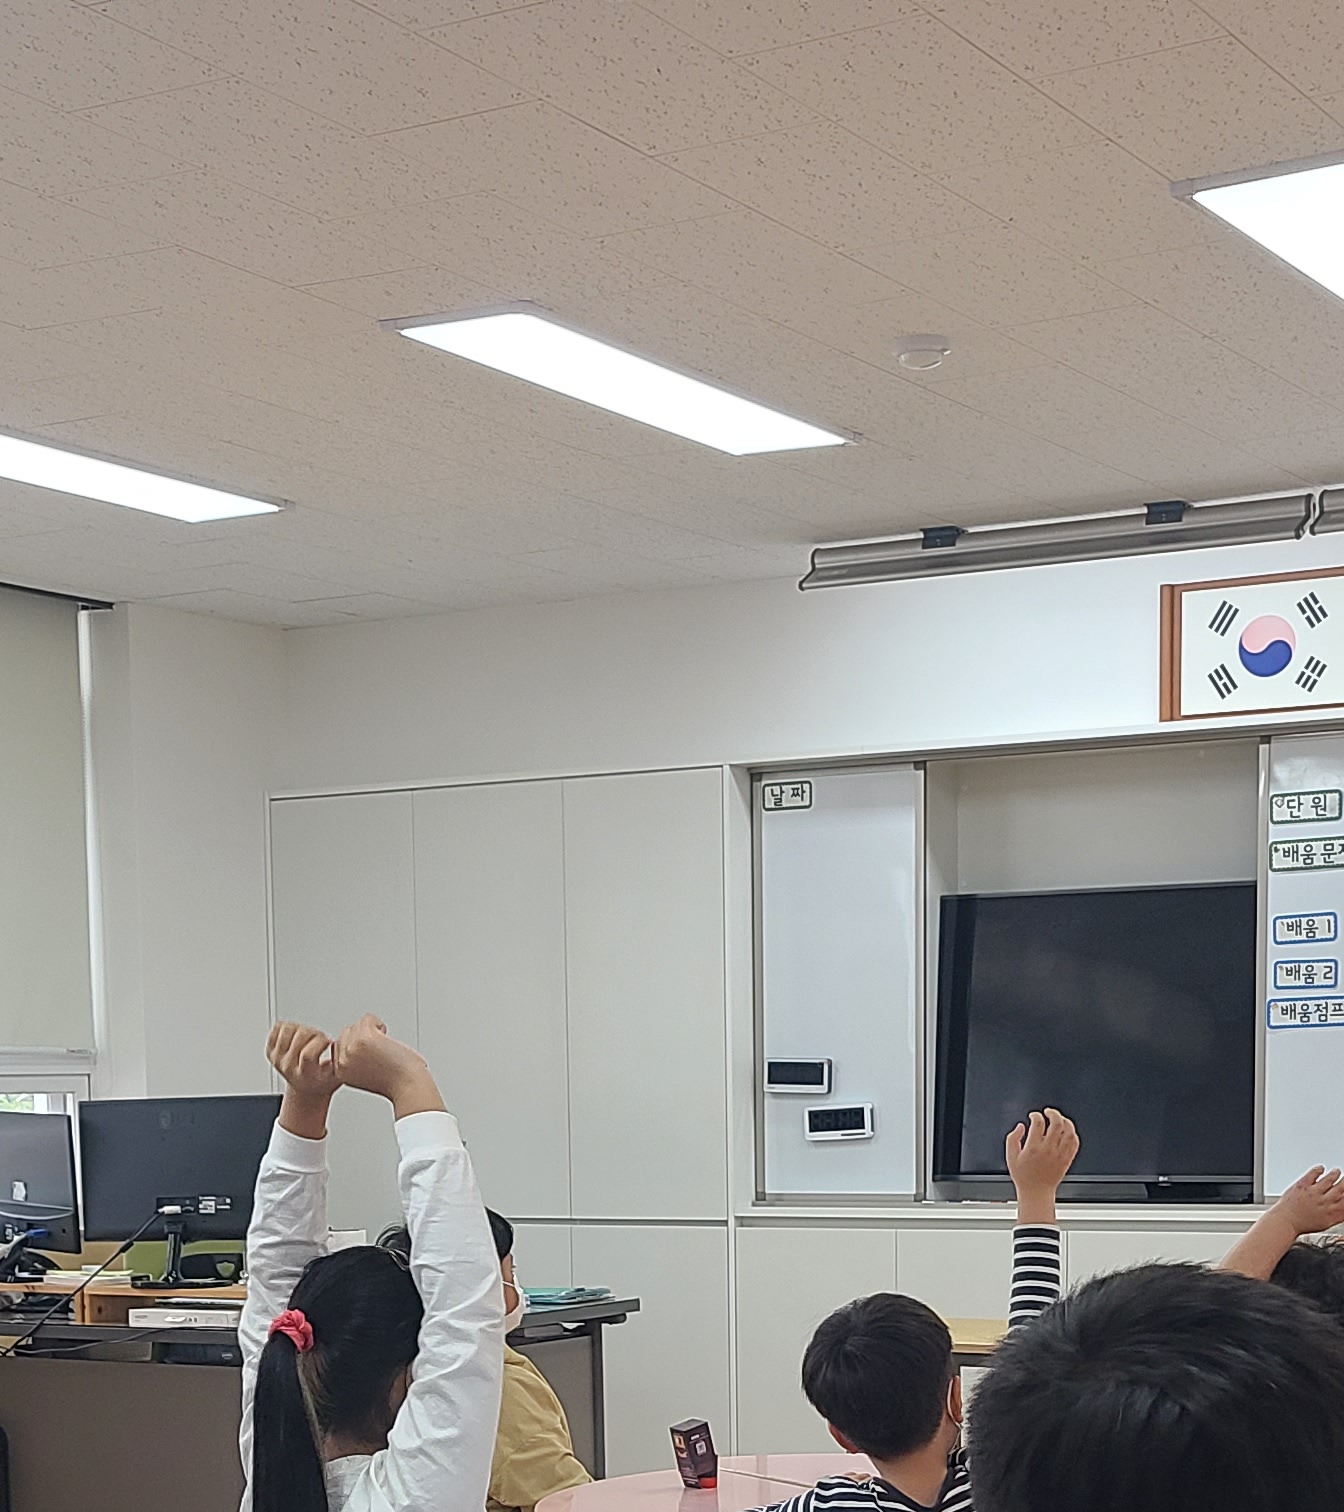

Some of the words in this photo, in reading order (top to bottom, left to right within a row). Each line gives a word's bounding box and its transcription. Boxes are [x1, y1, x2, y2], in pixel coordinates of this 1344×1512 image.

[1285, 918, 1319, 939] 배움
[1326, 918, 1332, 934] 1
[1284, 963, 1318, 985] 배움
[1322, 965, 1333, 980] 2
